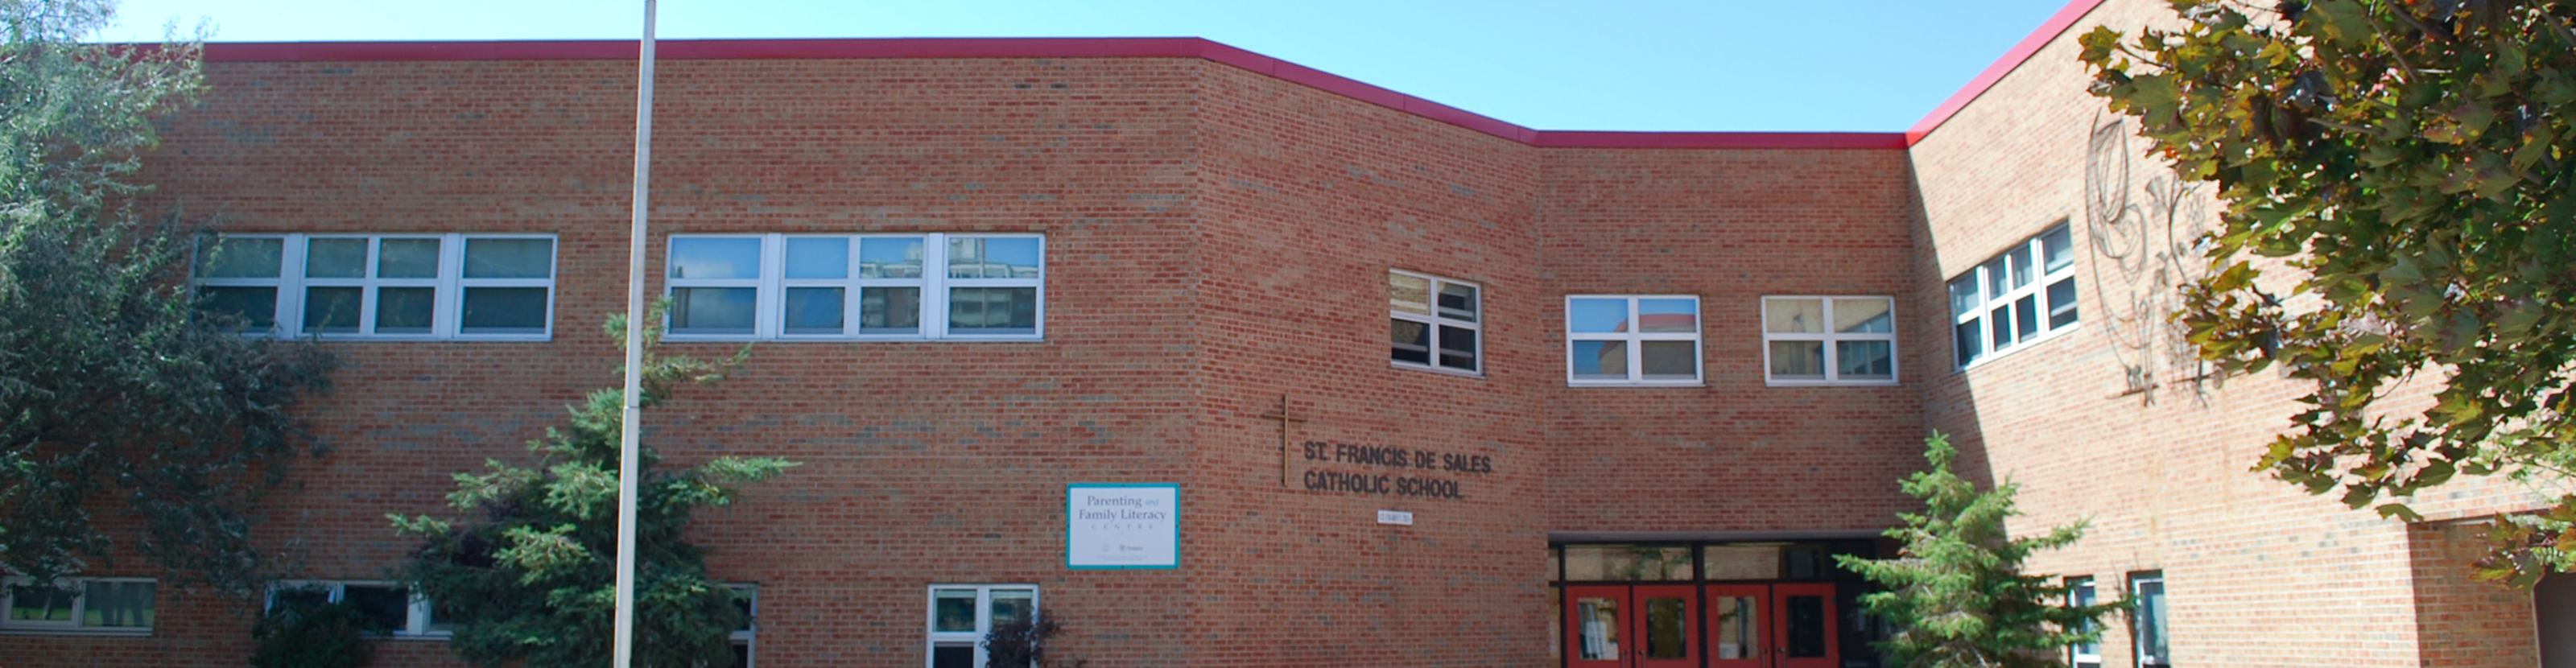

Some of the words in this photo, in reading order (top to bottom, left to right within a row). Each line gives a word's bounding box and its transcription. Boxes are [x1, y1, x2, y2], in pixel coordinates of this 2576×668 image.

[1304, 441, 1329, 461] ST.
[1336, 444, 1409, 468] FRANCIS
[1415, 452, 1435, 470] DE
[1443, 453, 1491, 474] SALES
[1304, 471, 1390, 494] CATHOLIC
[1397, 477, 1463, 499] SCHOOL
[1087, 496, 1142, 508] Parenting
[1079, 509, 1117, 522] Family
[1121, 509, 1166, 522] Literacy
